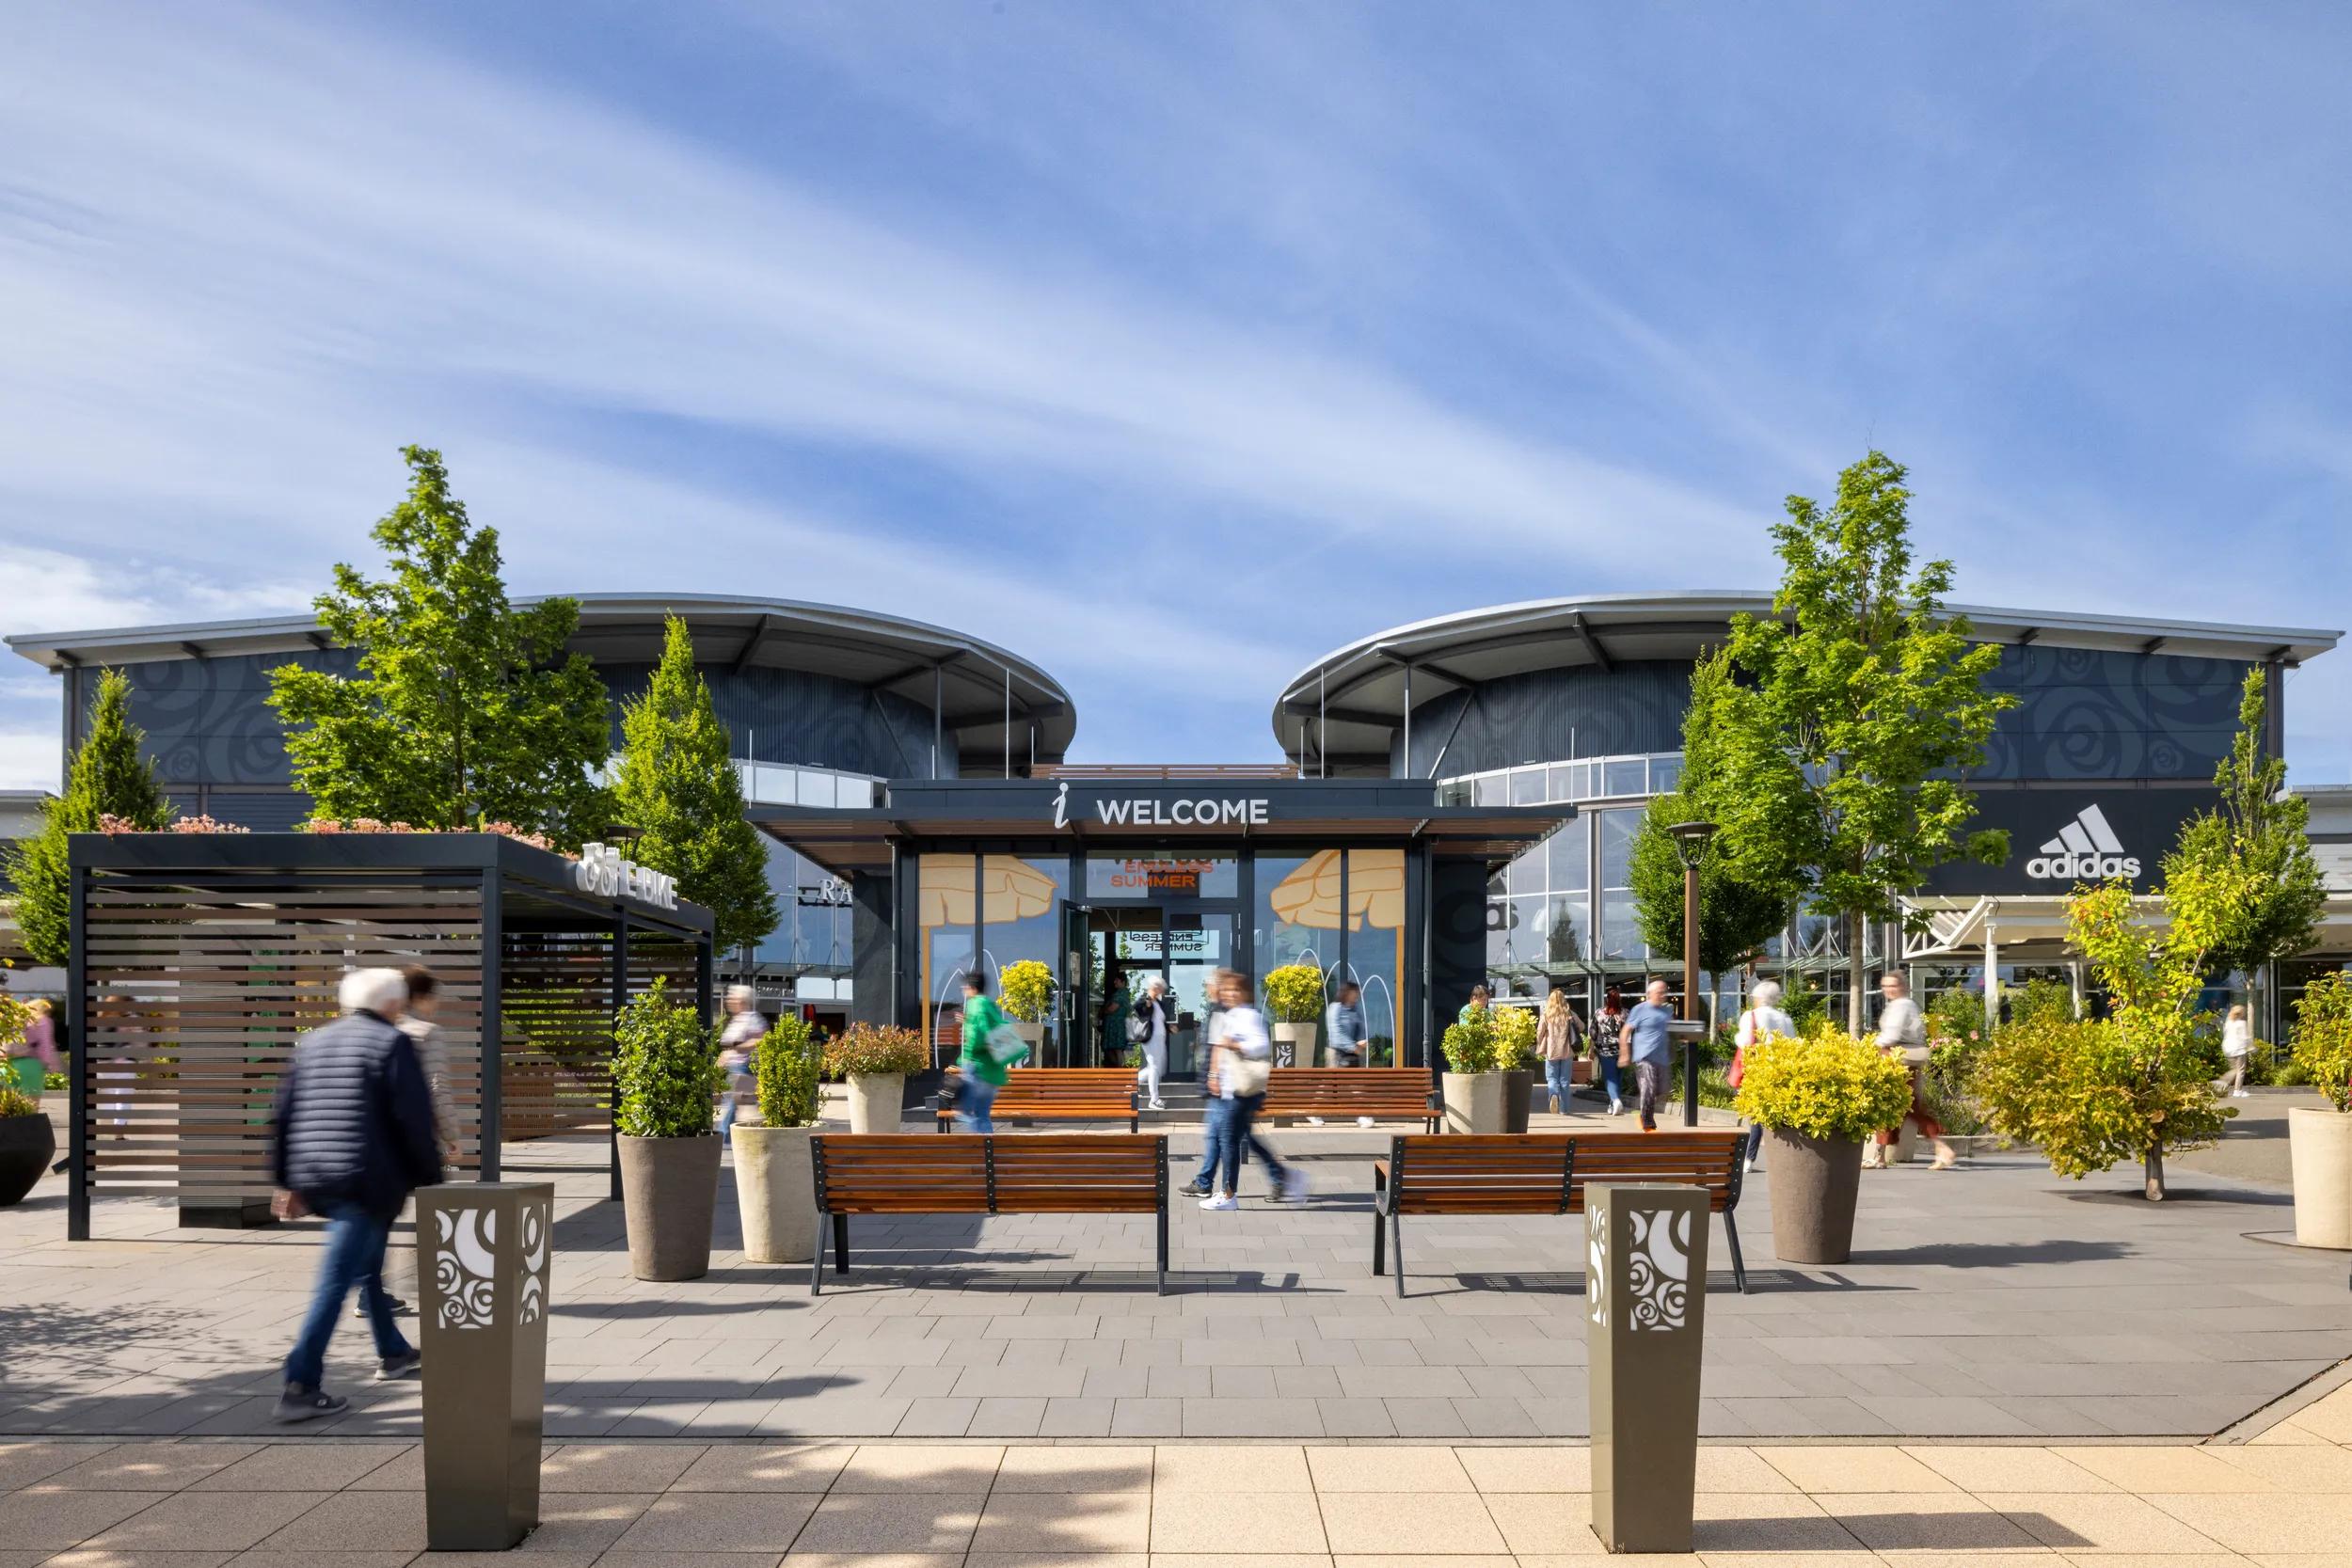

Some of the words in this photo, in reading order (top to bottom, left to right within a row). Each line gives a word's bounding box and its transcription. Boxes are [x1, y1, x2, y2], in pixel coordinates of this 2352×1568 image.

[1096, 799, 1269, 825] WELCOME
[1124, 860, 1214, 874] ENDLESS
[2026, 851, 2142, 879] adidas
[618, 860, 677, 911] E-BIKE
[1111, 875, 1197, 888] SUMMER
